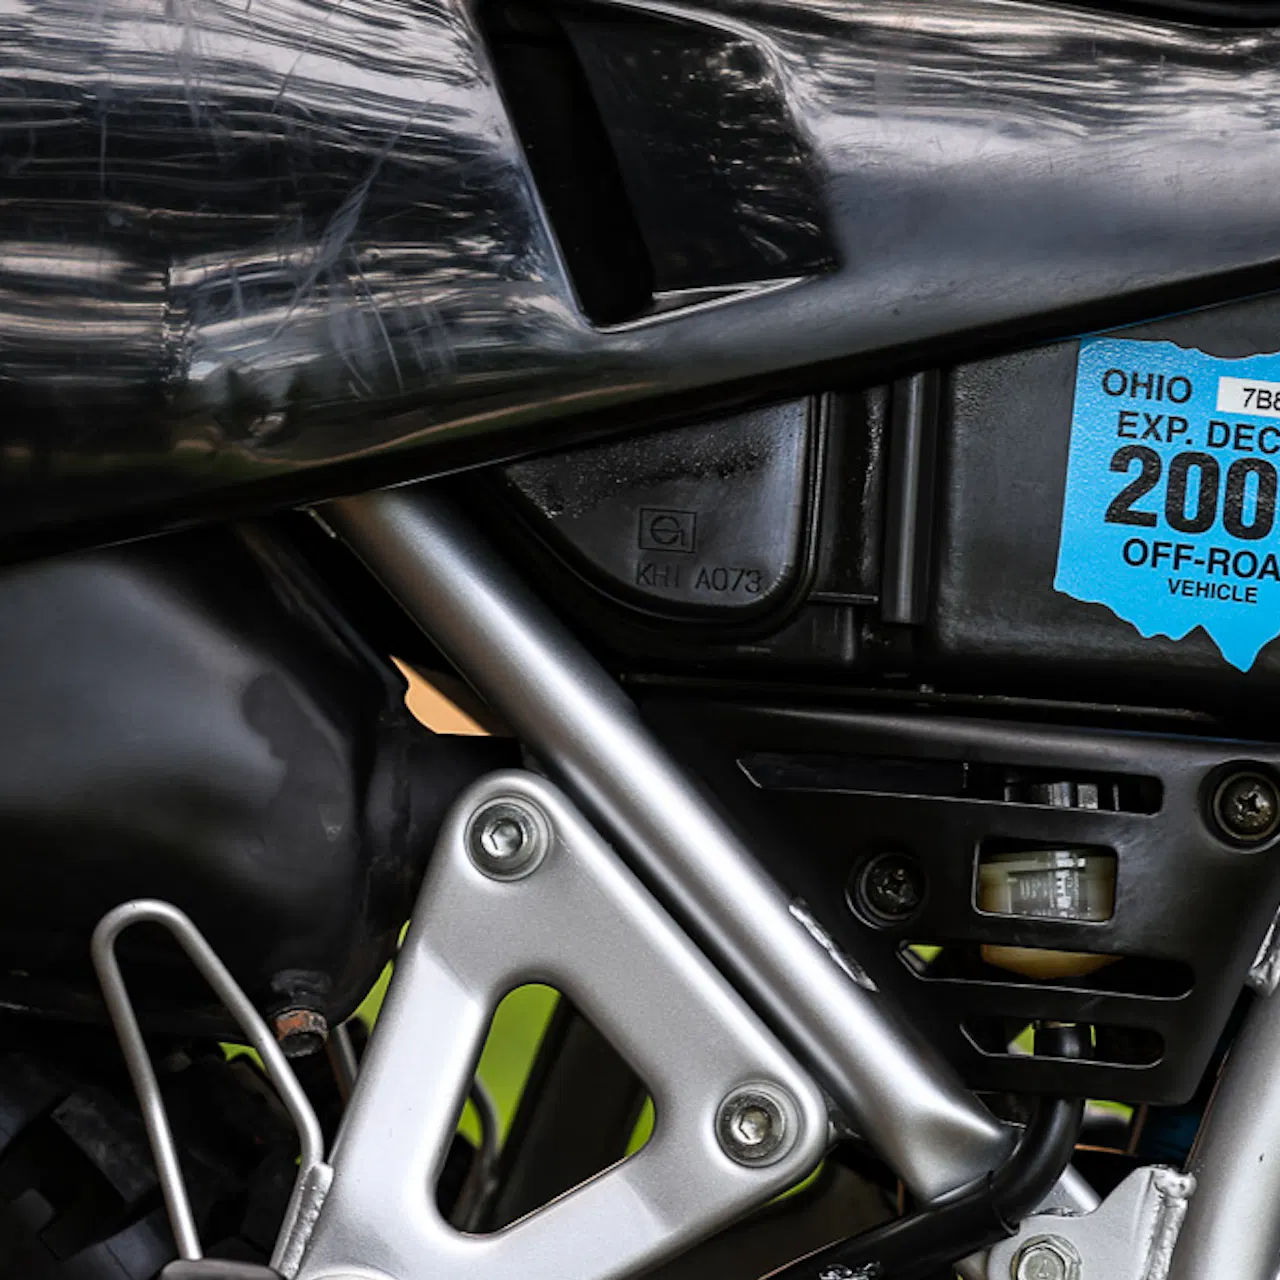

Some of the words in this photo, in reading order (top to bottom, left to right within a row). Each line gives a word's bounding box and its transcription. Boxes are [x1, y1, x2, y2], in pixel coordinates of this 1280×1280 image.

[1102, 369, 1193, 403] OHIO
[1118, 411, 1193, 444] EXP.
[635, 563, 680, 588] KHI
[695, 567, 763, 593] A073
[1168, 579, 1258, 603] VEHICLE
